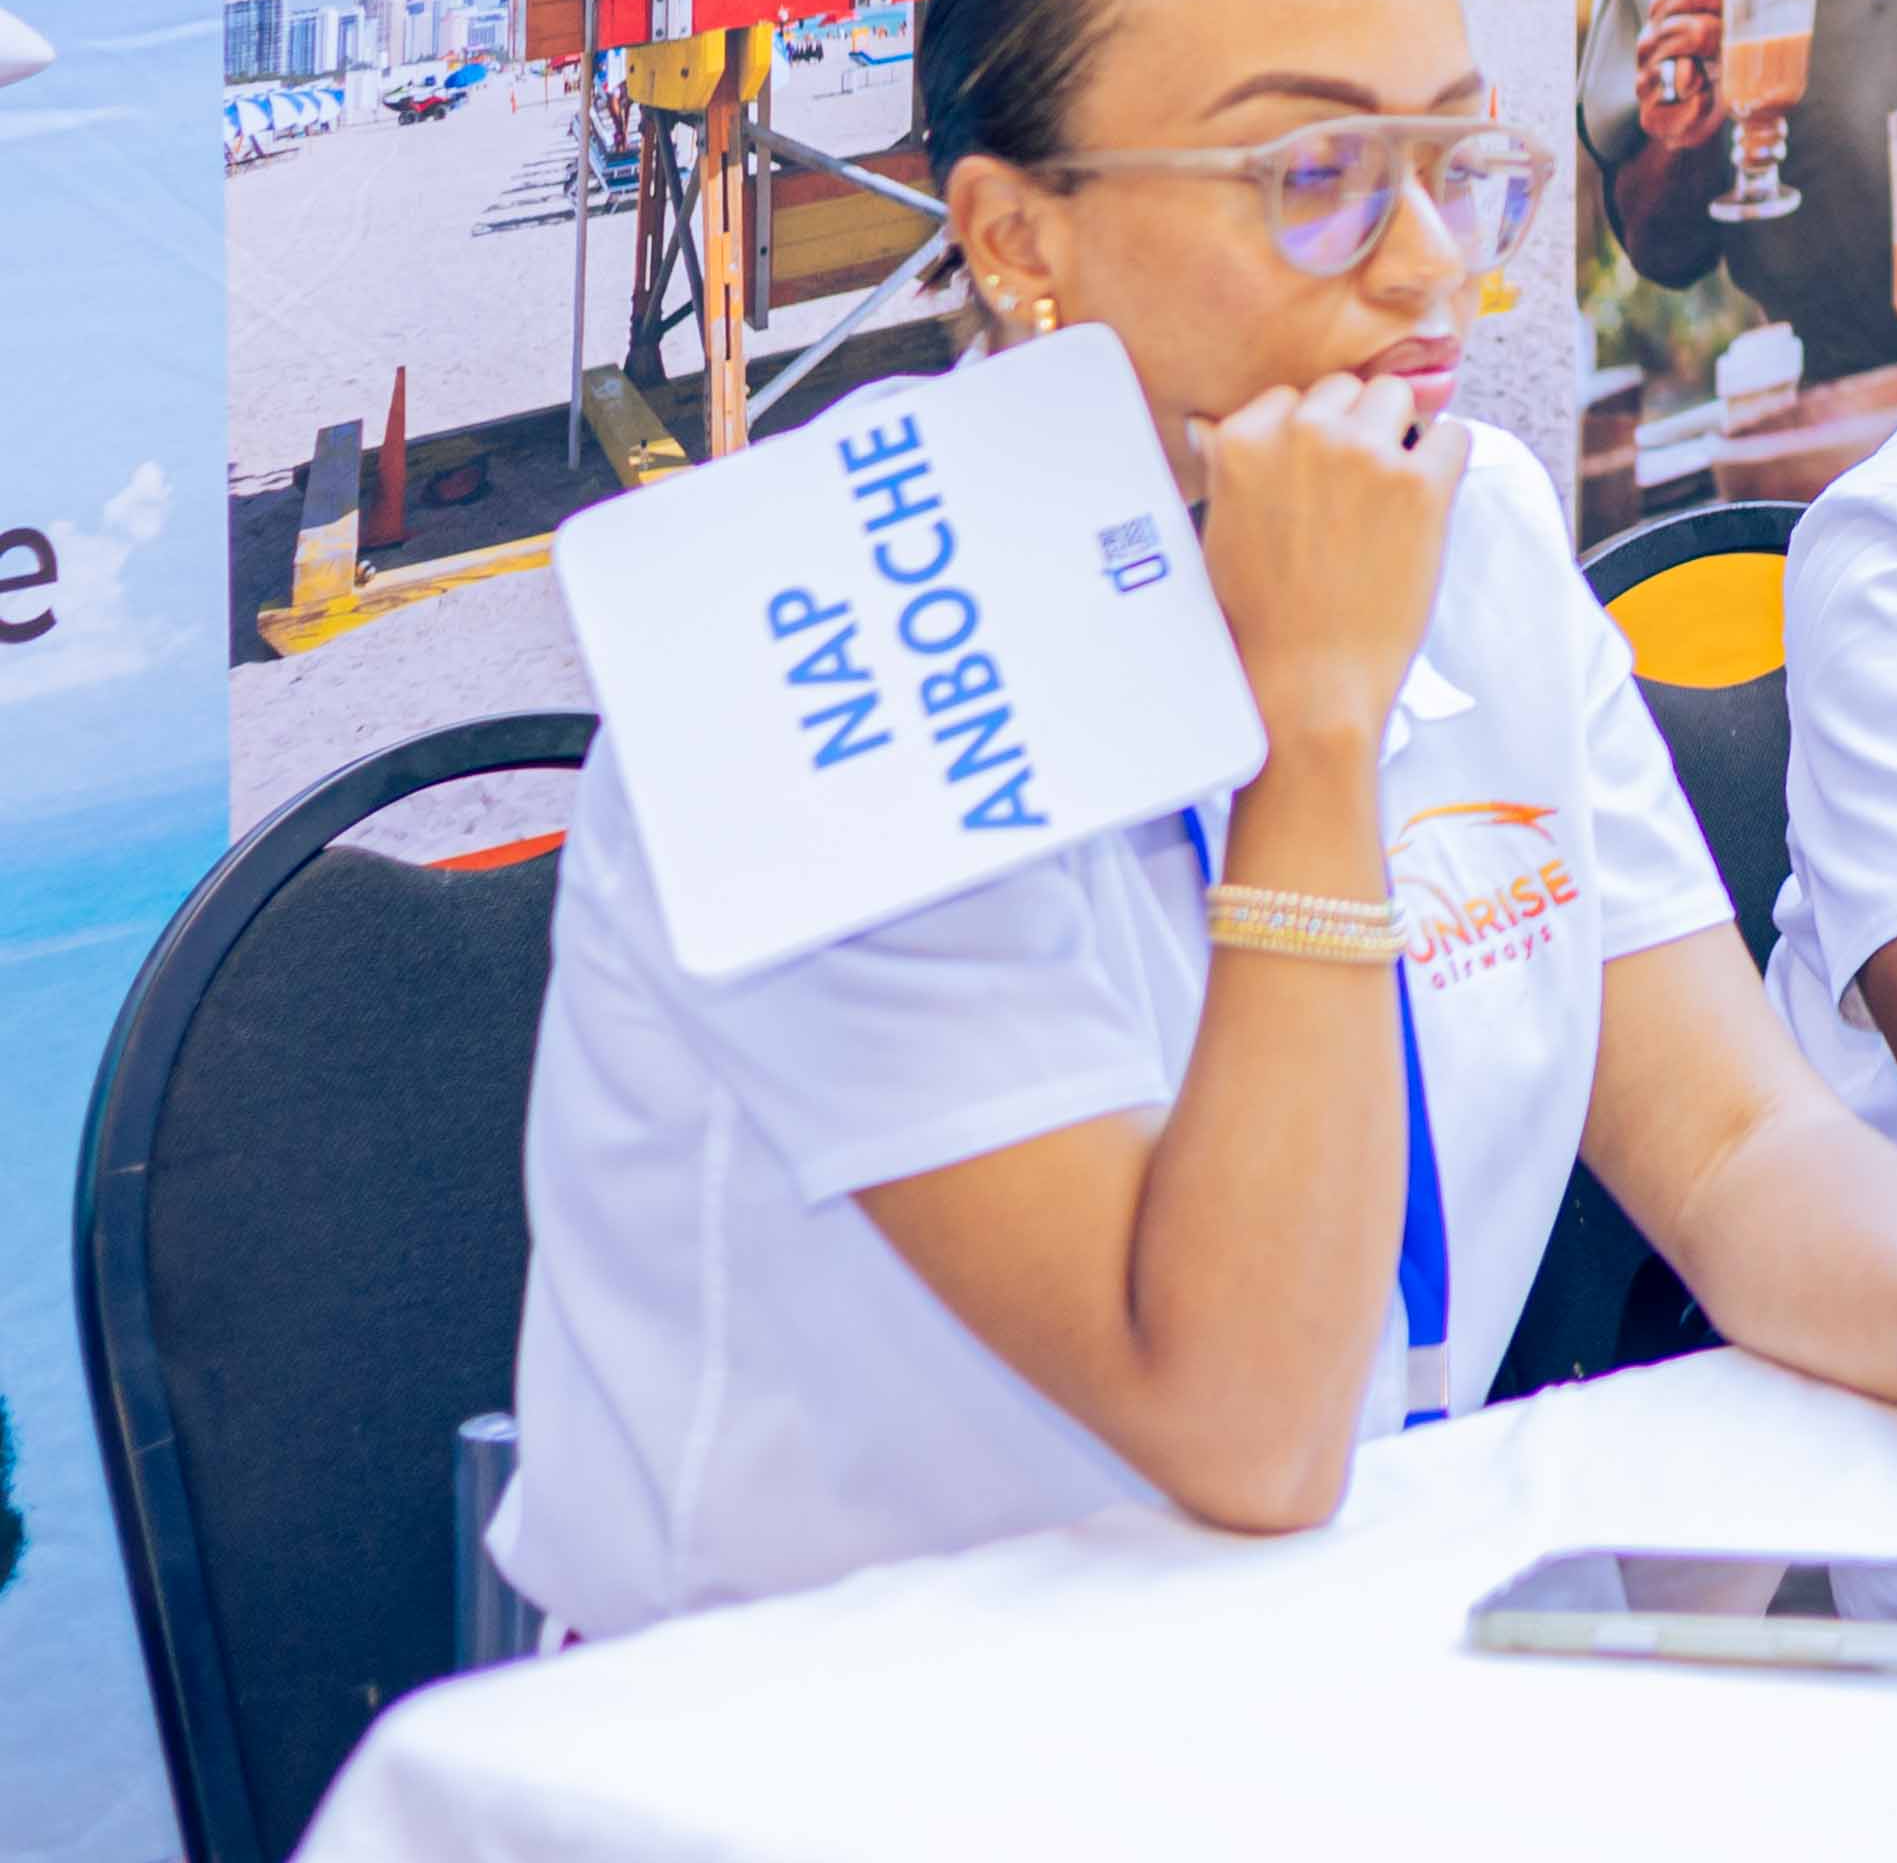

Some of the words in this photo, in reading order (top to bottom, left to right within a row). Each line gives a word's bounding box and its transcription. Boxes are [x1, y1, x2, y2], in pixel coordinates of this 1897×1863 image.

[765, 586, 894, 771] NAP
[837, 413, 1051, 833] ANBOCHE
[1406, 858, 1579, 965] UNRISE
[1431, 924, 1553, 990] airways
